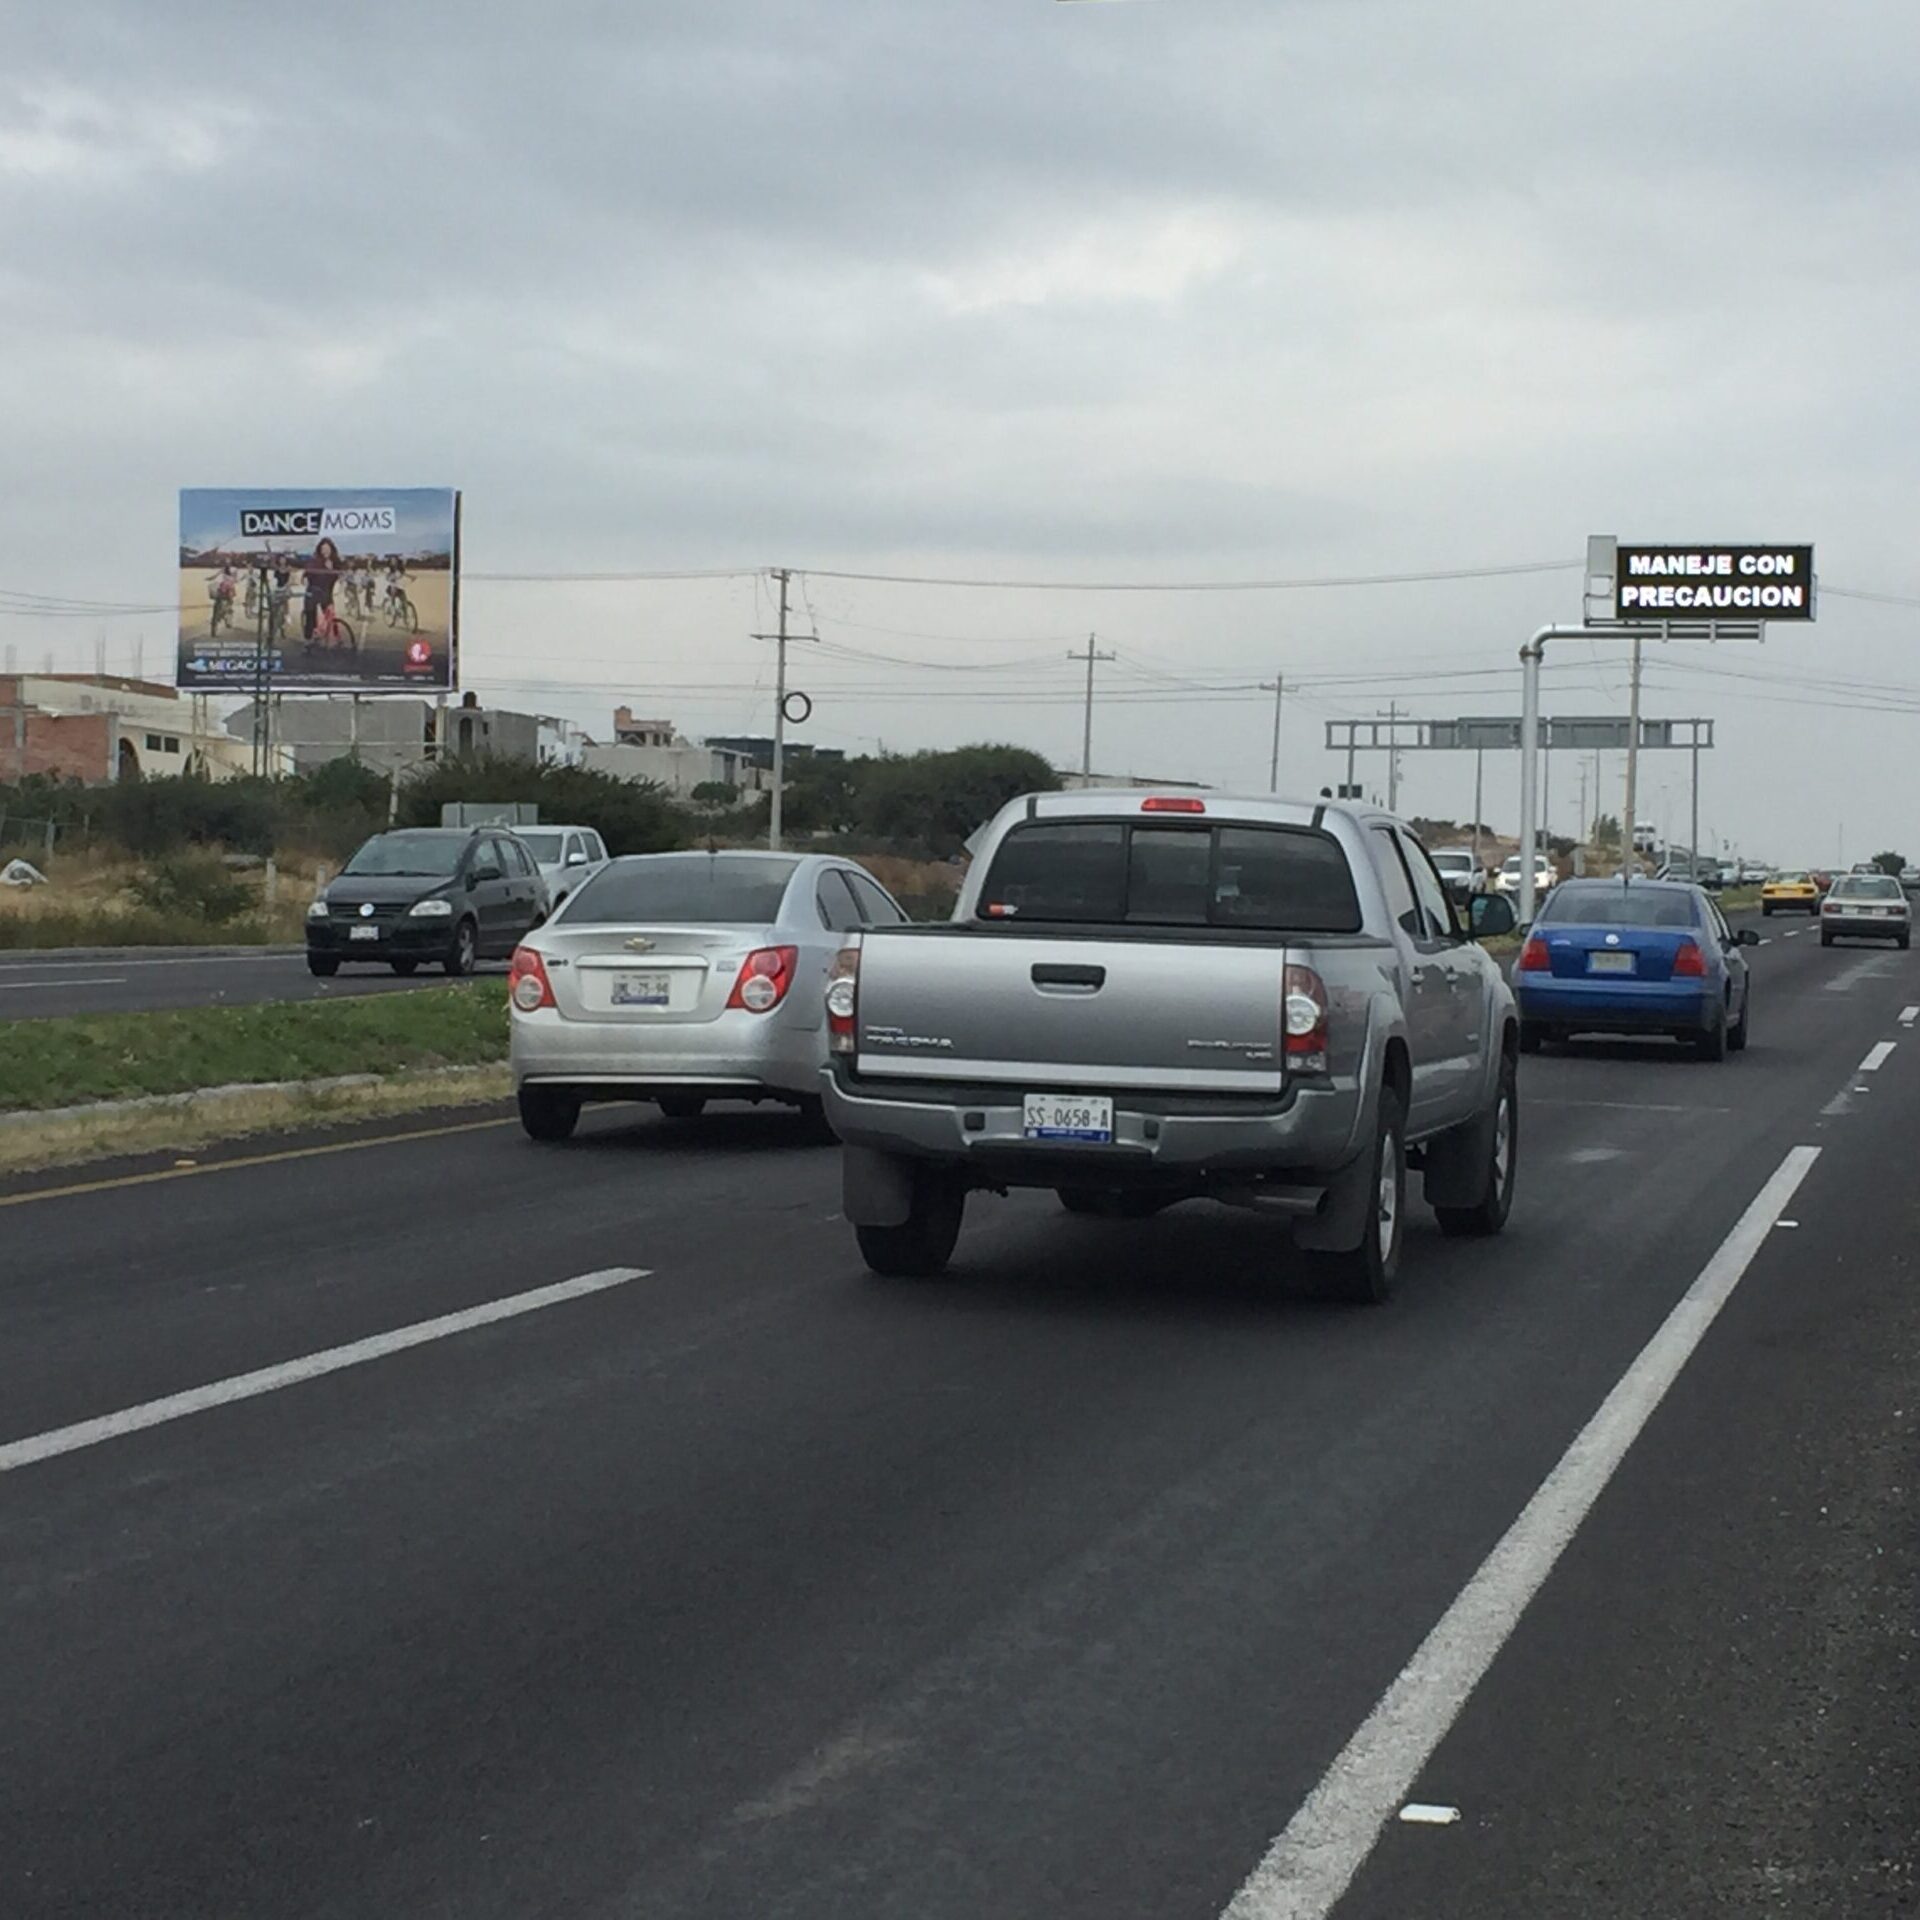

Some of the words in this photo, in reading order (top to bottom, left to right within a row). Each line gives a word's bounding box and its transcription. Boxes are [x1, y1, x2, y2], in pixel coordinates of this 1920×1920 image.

[244, 512, 319, 533] DANCE
[324, 511, 392, 530] MOMS
[1629, 555, 1732, 575] MANEJE
[1738, 555, 1794, 575] CON
[1621, 586, 1802, 607] PRECAUCION
